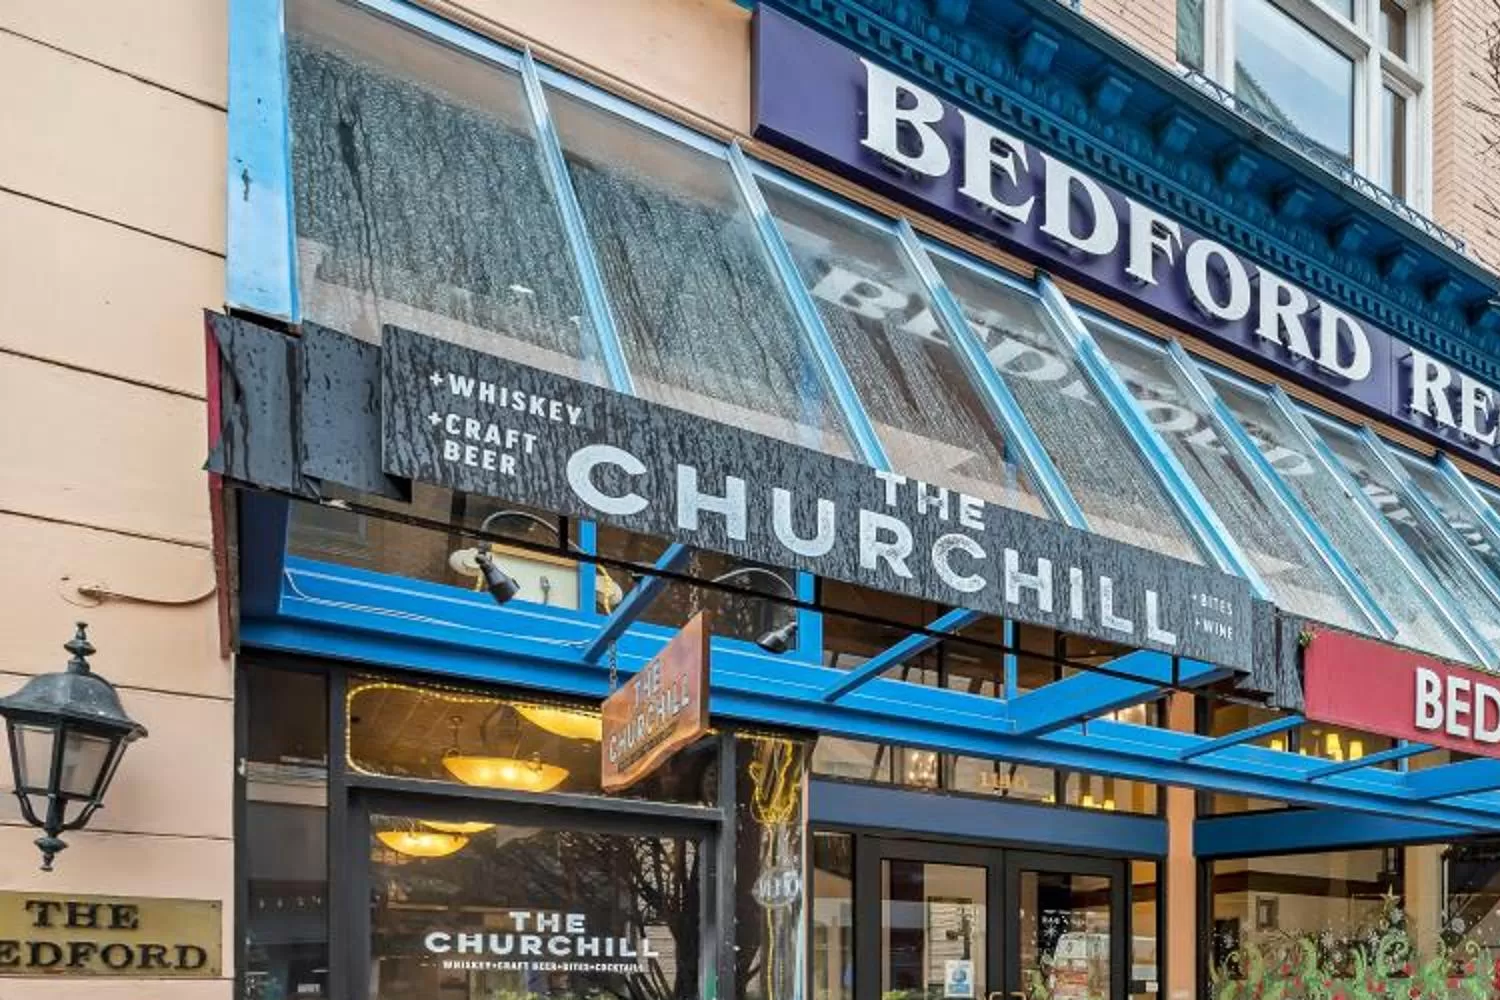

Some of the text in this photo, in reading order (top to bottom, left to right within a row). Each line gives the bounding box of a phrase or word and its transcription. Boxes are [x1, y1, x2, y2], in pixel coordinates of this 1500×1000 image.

[856, 56, 1373, 382] BEDFORD
[443, 439, 517, 477] BEER
[875, 470, 986, 532] THE
[566, 443, 1177, 647] CHURCHILL
[25, 899, 140, 930] THE
[508, 910, 586, 934] THE
[0, 939, 208, 971] EDFORD
[423, 931, 659, 958] CHURCHILL
